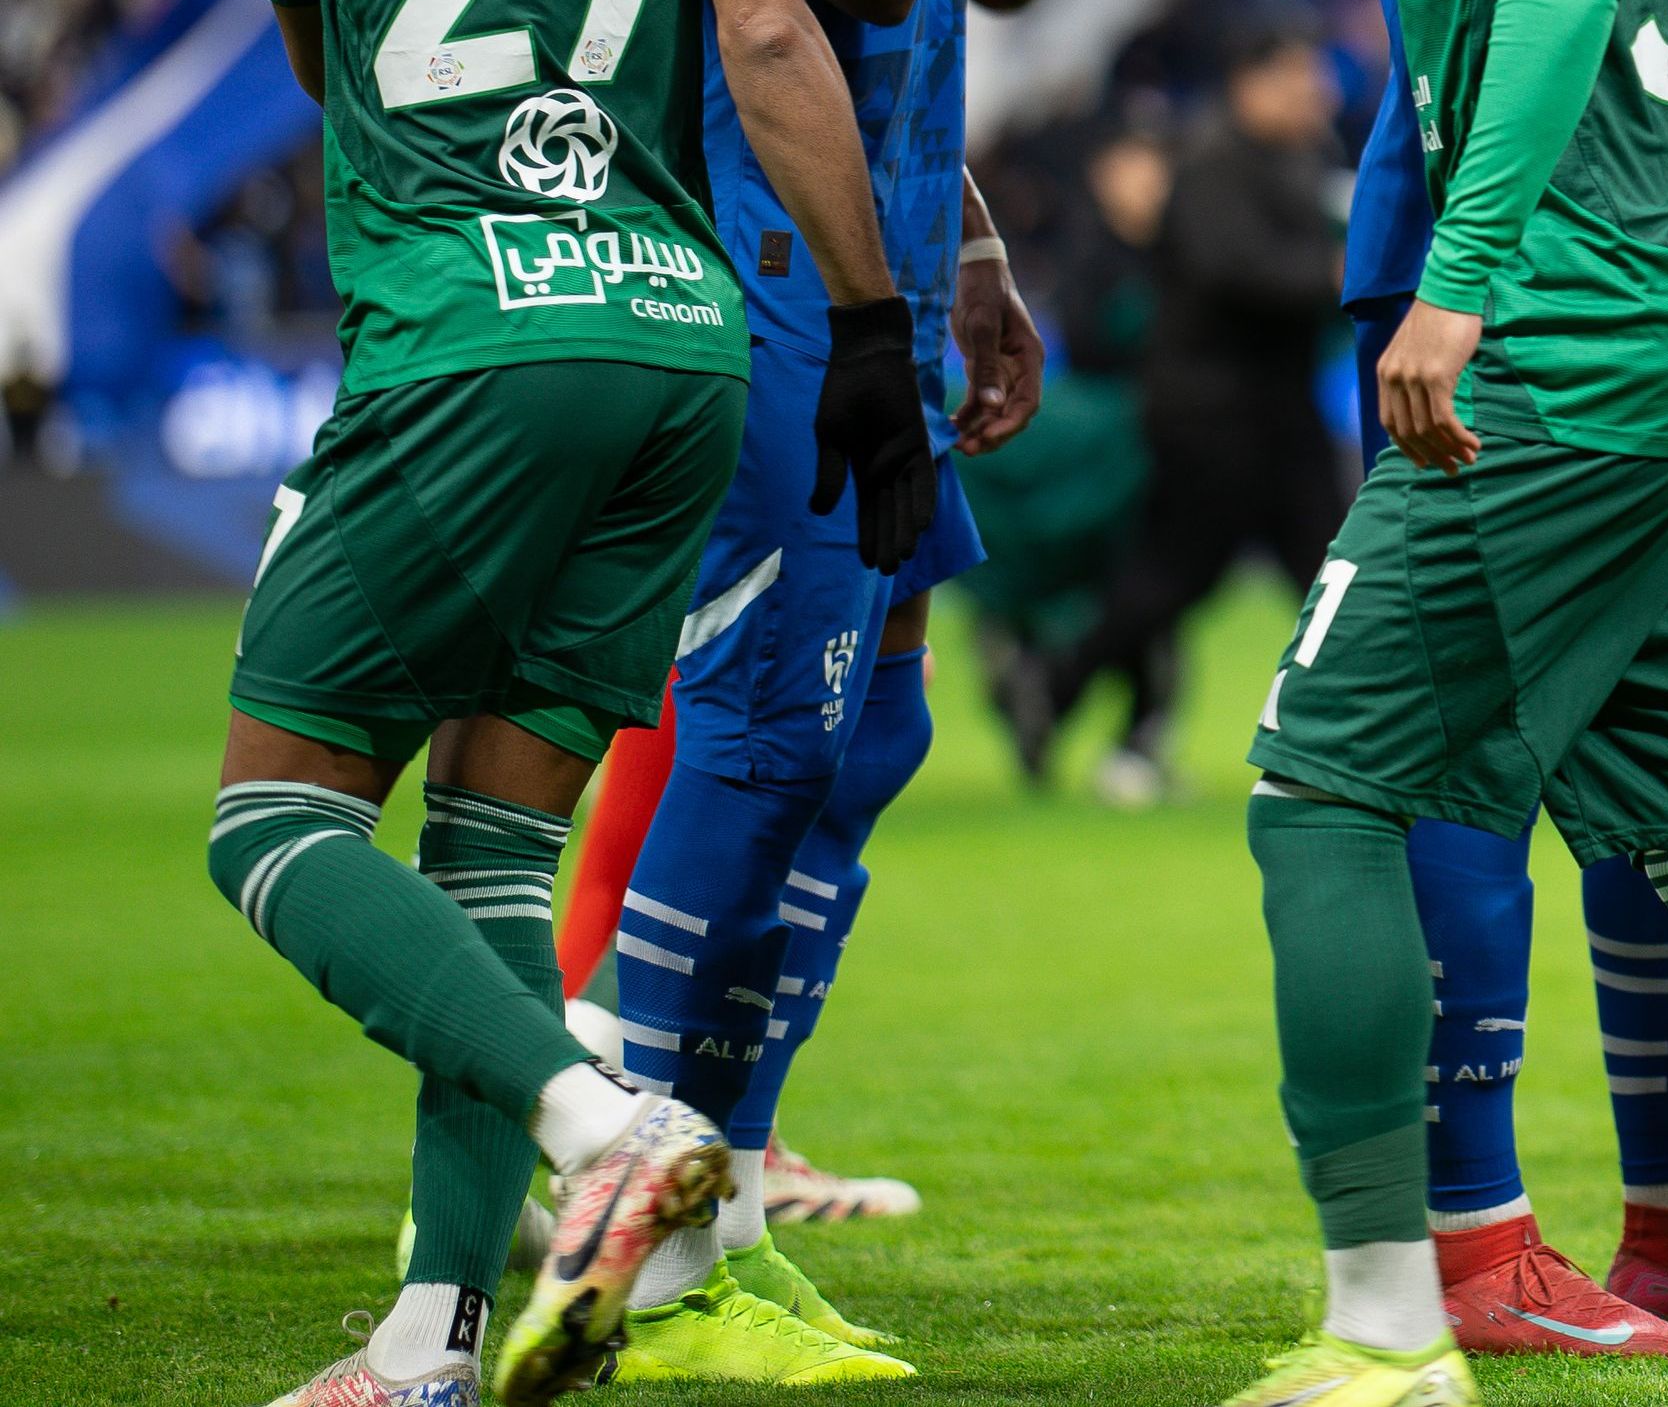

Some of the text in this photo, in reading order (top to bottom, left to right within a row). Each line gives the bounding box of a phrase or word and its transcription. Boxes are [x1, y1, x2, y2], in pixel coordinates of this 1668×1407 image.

[1293, 557, 1358, 669] 1
[696, 1036, 735, 1059] AL
[1454, 1064, 1494, 1083] AL
